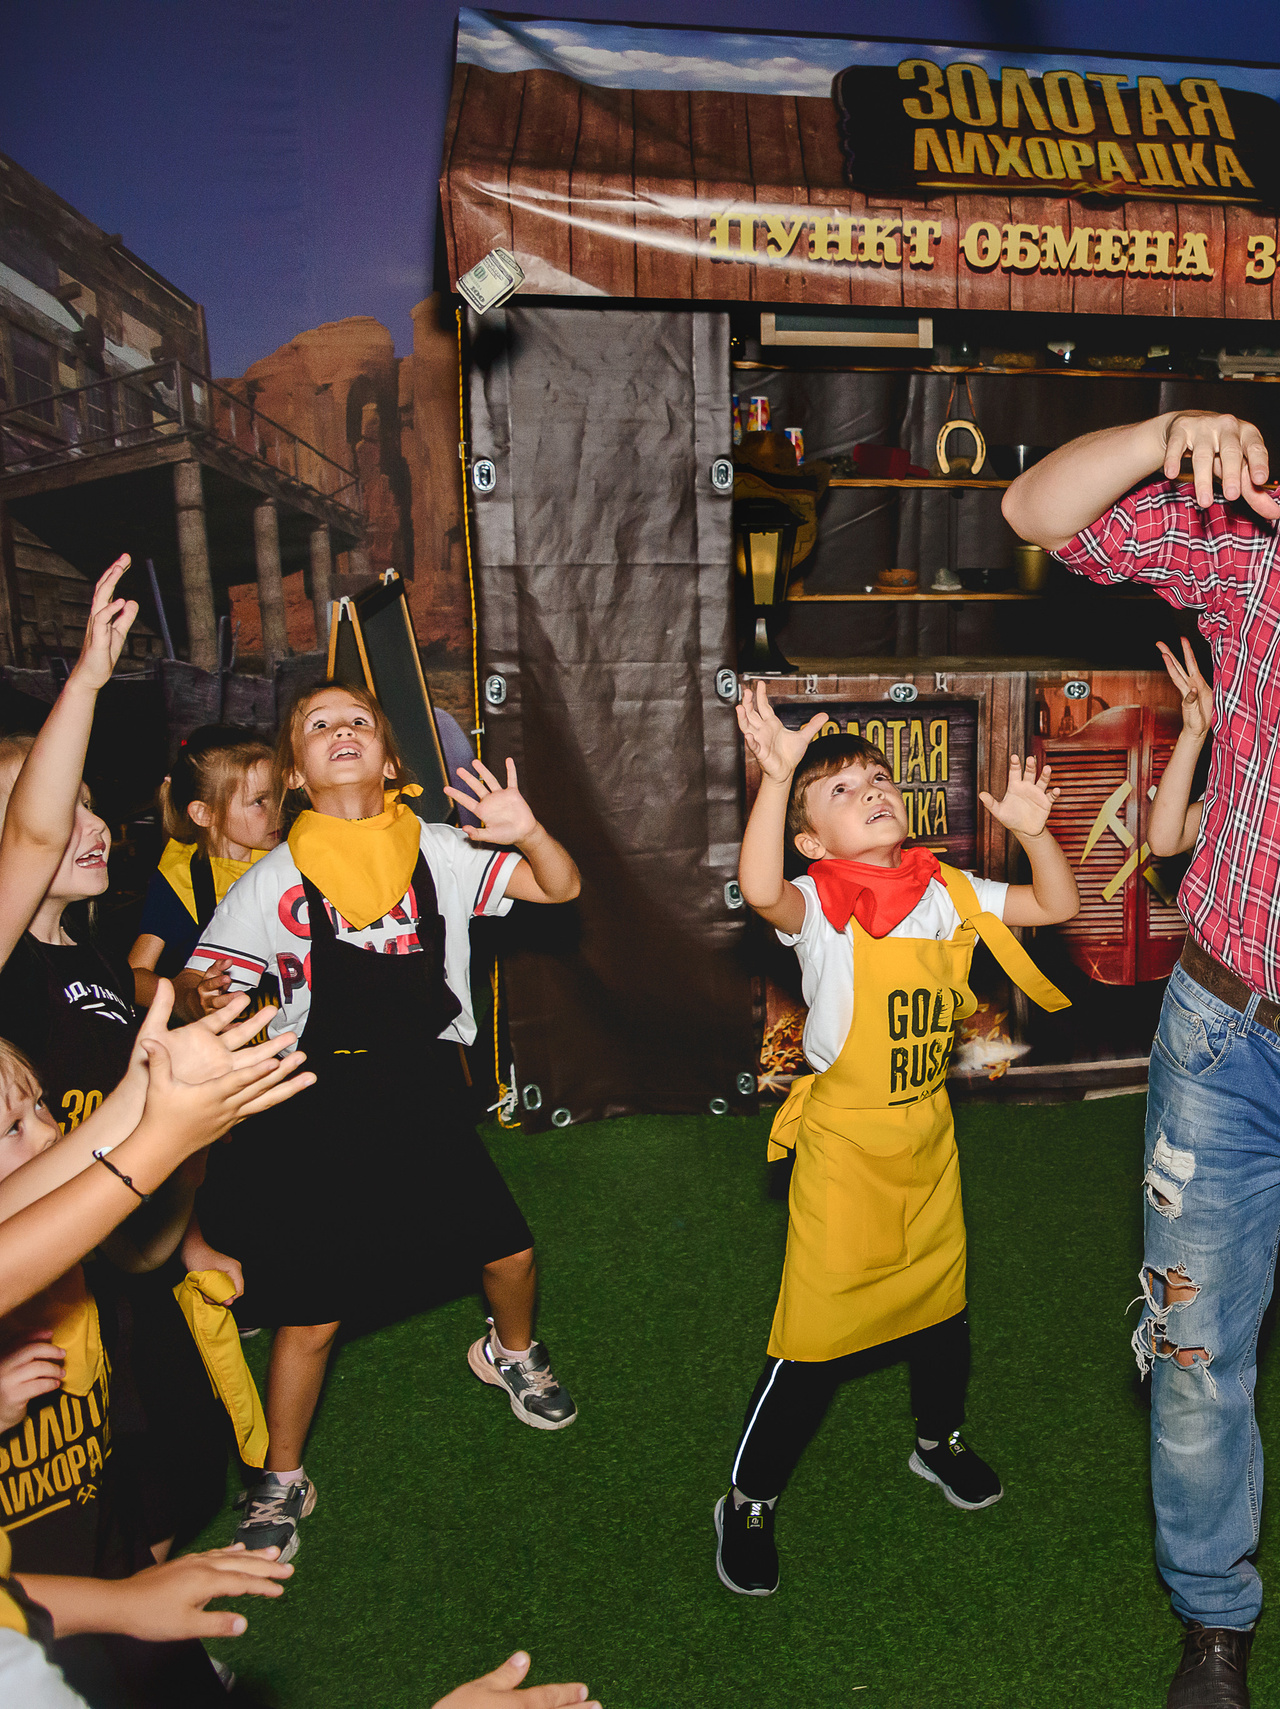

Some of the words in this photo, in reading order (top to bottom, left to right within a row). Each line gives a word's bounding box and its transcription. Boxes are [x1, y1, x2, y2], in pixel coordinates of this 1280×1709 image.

[898, 59, 1236, 140] ЗОЛОТАЯ
[913, 127, 1255, 189] ЛИХОРАДКА
[709, 212, 942, 266] ПУНКТ
[959, 221, 1215, 278] ОБМЕНА
